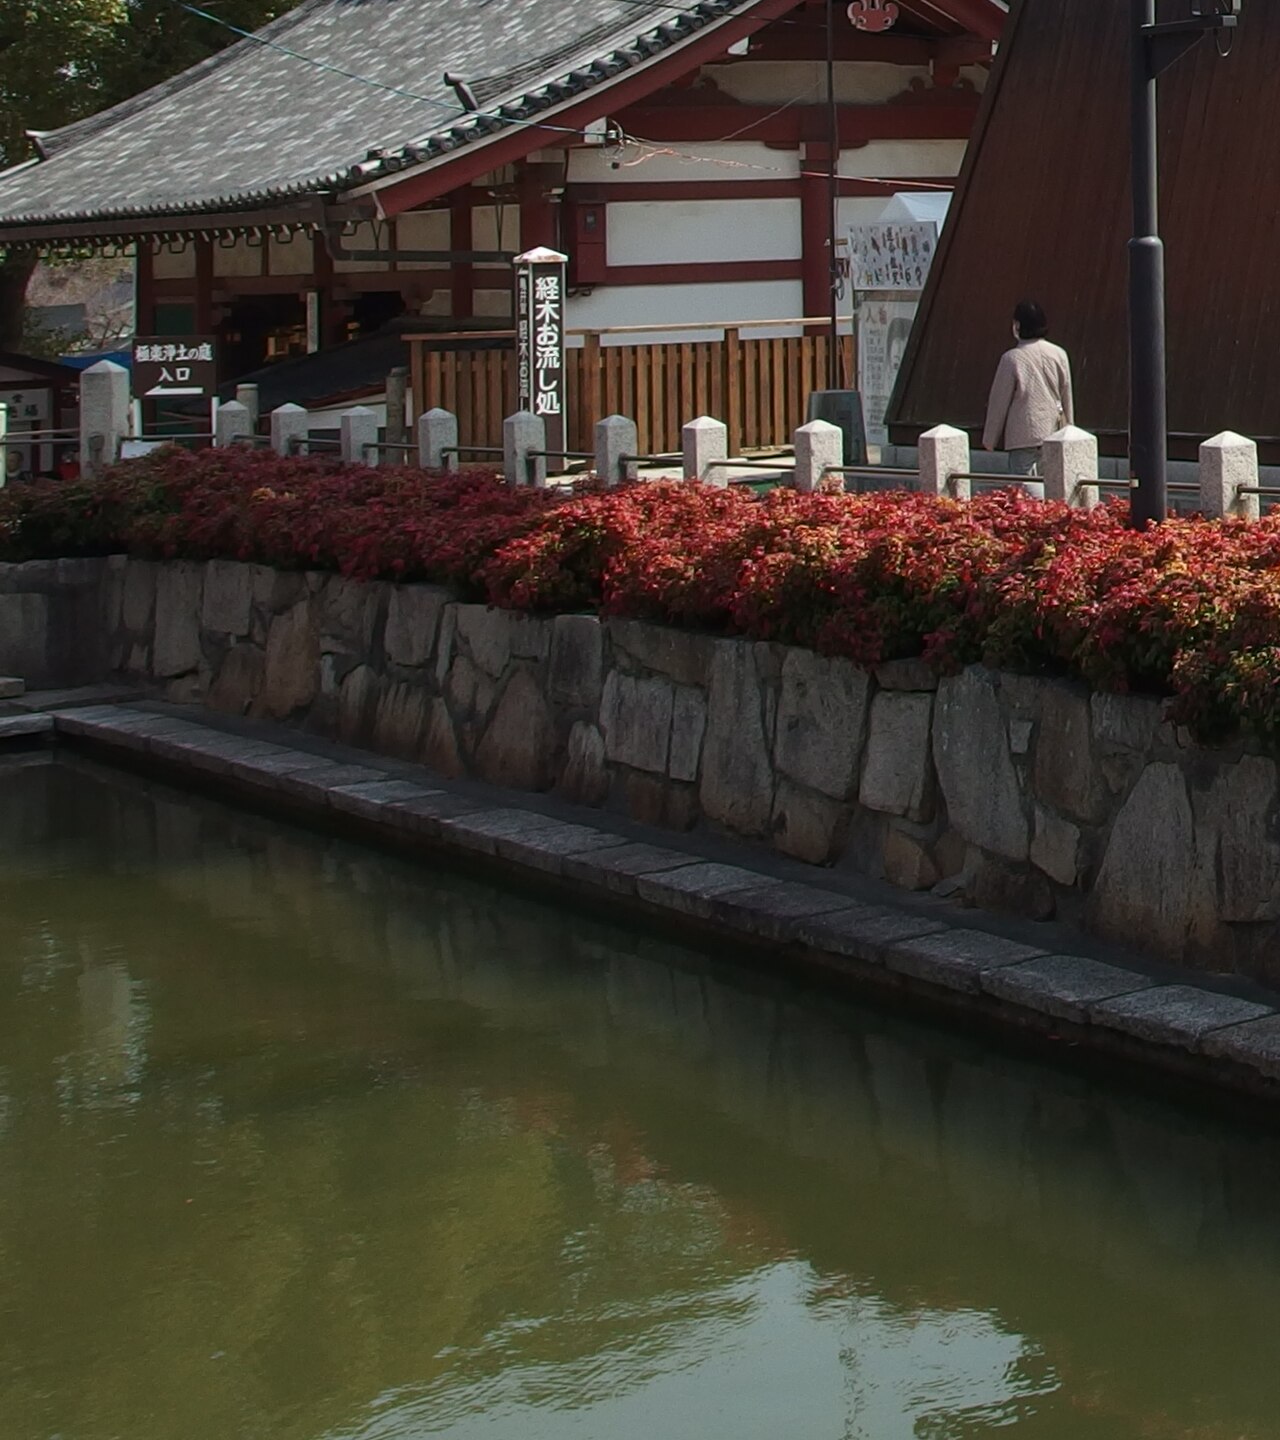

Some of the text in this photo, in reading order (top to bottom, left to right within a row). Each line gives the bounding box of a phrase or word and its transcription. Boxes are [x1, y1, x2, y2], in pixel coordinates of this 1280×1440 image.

[135, 343, 213, 362] 極楽浄土の庭
[534, 275, 561, 415] 経木お流し処
[158, 366, 191, 382] 入口
